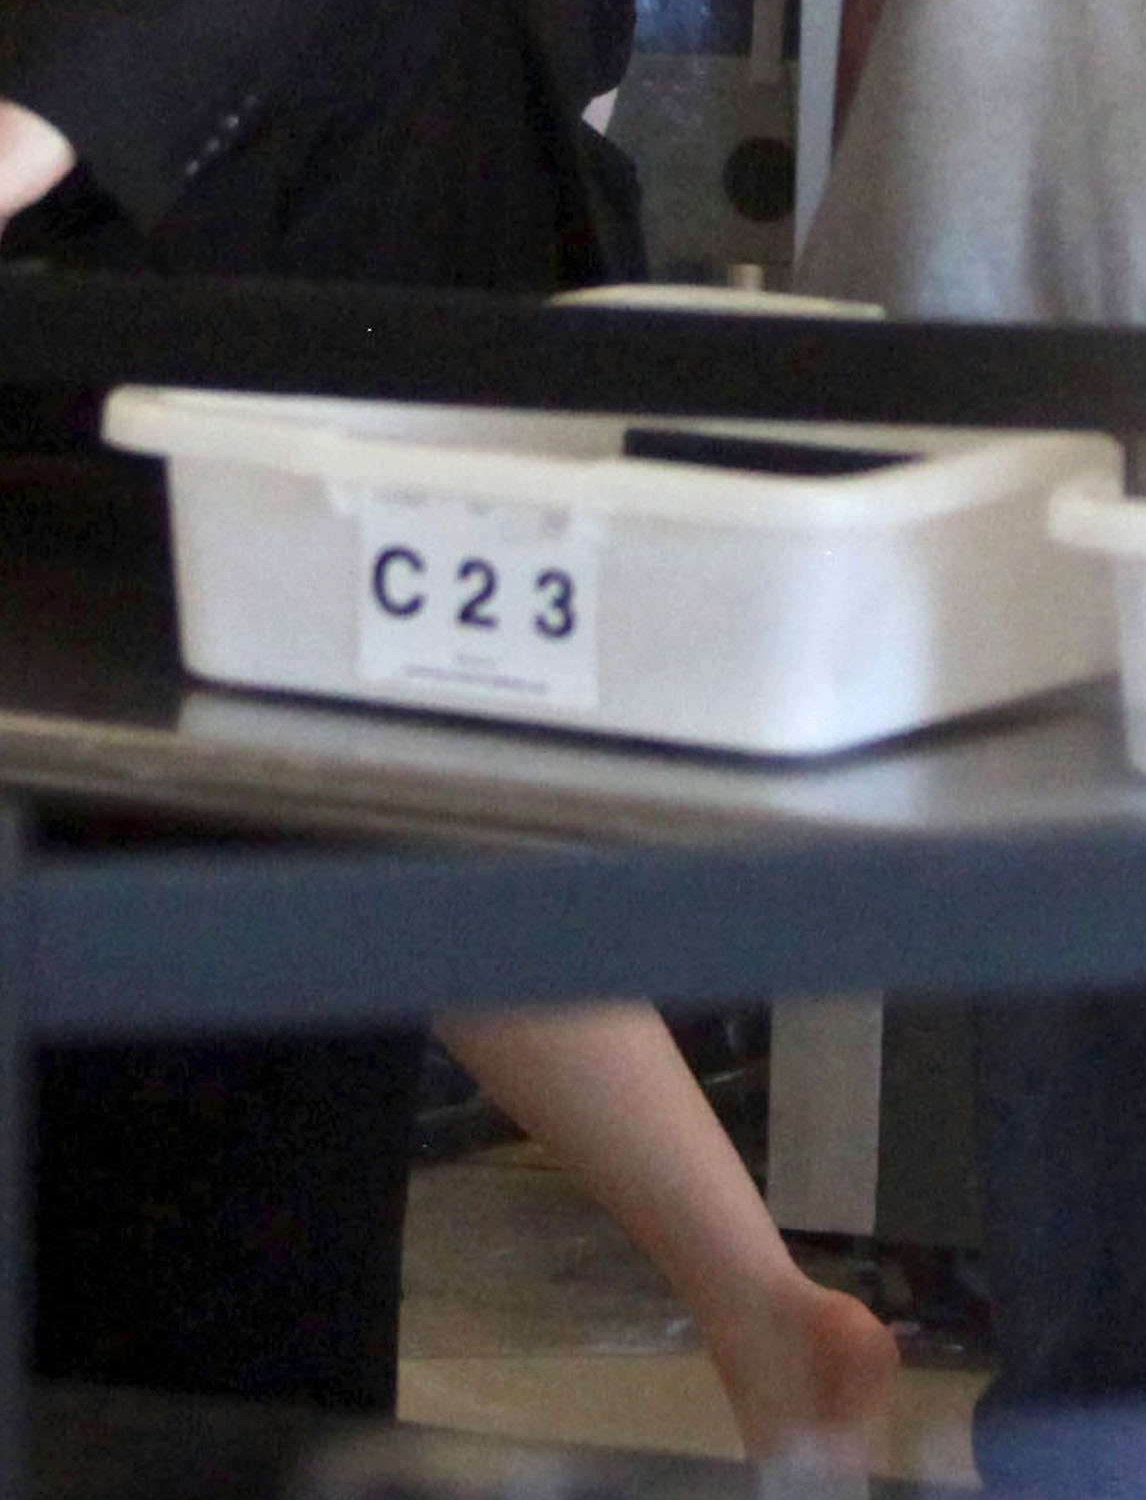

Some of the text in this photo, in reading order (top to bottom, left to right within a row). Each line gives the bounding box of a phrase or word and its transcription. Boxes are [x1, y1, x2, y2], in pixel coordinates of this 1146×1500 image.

[373, 545, 576, 639] C 2 3
